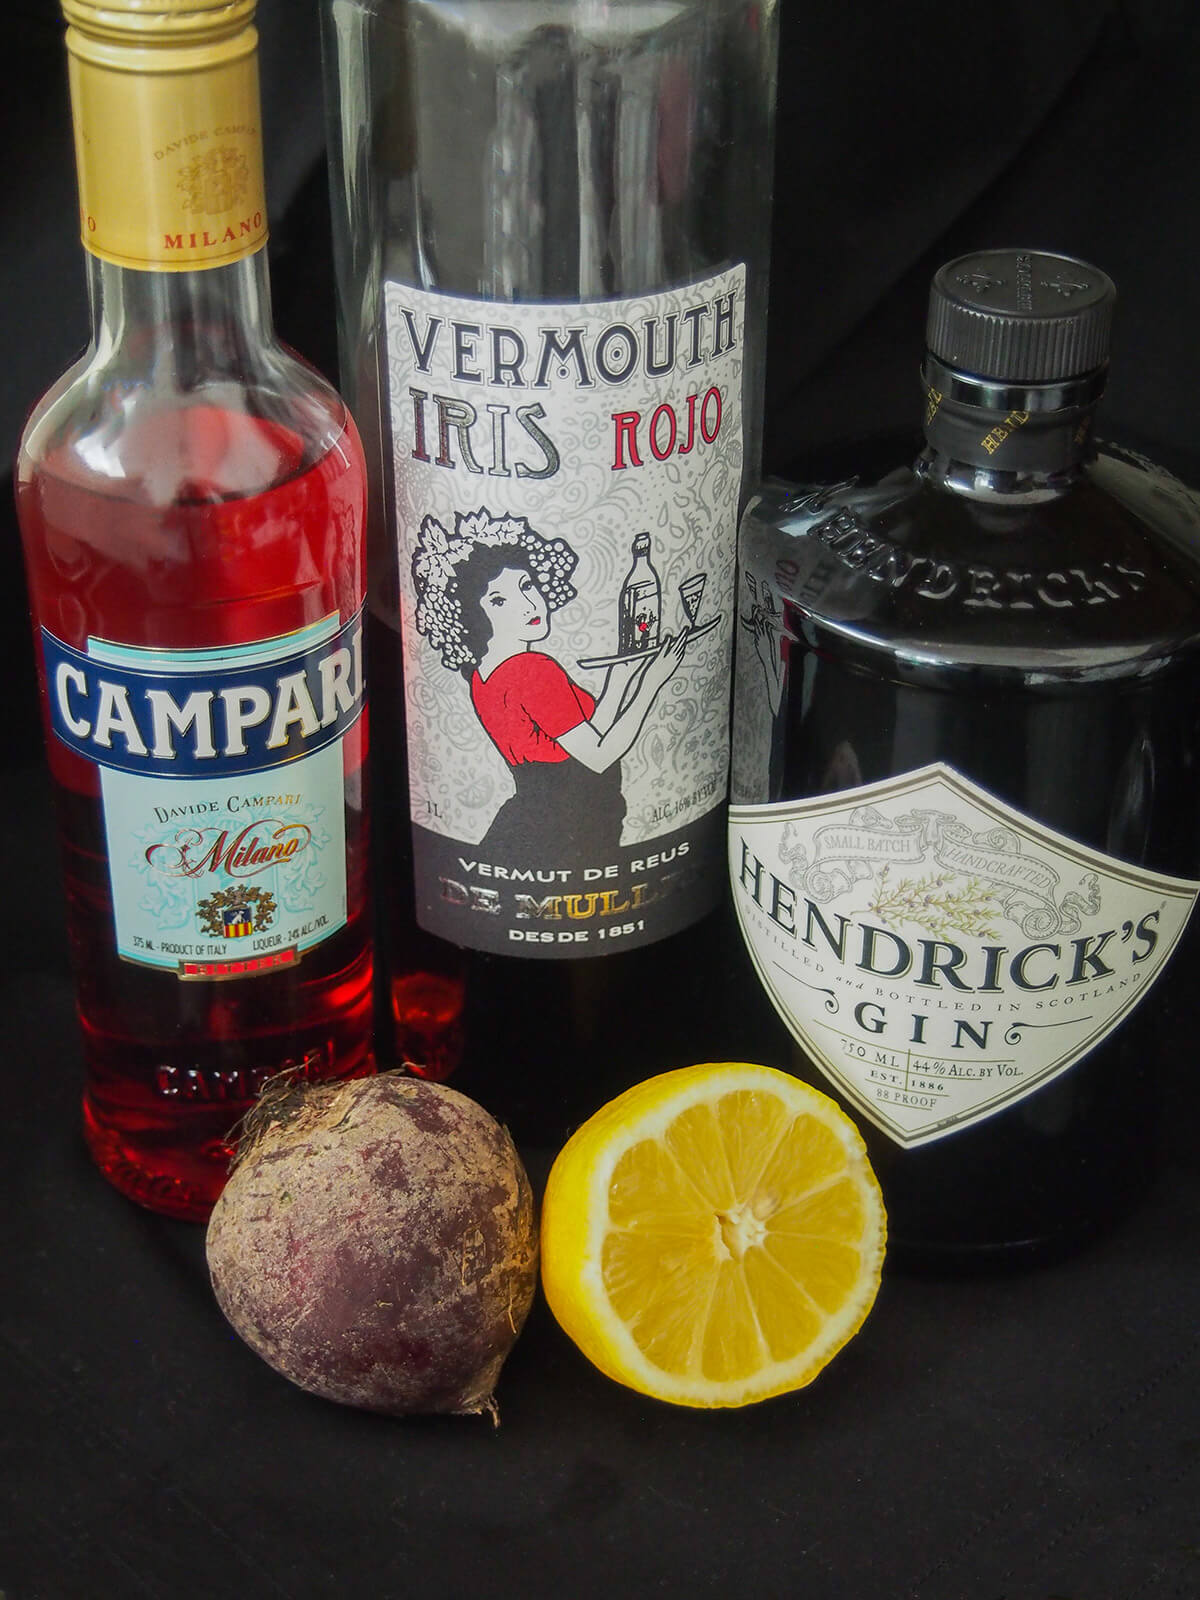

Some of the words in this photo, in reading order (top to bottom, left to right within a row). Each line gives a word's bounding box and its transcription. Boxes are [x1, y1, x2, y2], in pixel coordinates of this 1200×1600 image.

[153, 129, 208, 160] DAVIDE
[164, 211, 262, 249] MILANO
[398, 290, 737, 390] VERMOUTH
[408, 387, 560, 479] IRIS
[611, 387, 723, 471] ROJO
[56, 629, 367, 760] CAMPARI
[458, 857, 572, 883] VERMUT
[584, 864, 619, 881] DE
[631, 841, 691, 874] REUS
[825, 836, 865, 850] SMALL
[867, 838, 911, 853] BATCH
[947, 848, 1050, 889] HANDCRAFTED
[439, 876, 502, 915] DE
[508, 929, 589, 944] DESDE
[598, 920, 646, 939] 1851
[739, 838, 1160, 993] HENDRICK'S
[161, 942, 193, 955] PRODUCT
[195, 944, 205, 955] OF
[206, 944, 228, 955] ITALY
[253, 934, 282, 951] LIQUEUR
[835, 974, 864, 990] and
[875, 987, 982, 1011] BOTTLED
[997, 1002, 1021, 1012] IN
[1035, 972, 1142, 1010] SCOTLAND
[854, 1001, 994, 1050] GIN
[840, 1038, 866, 1057] 750
[874, 1052, 899, 1068] ML
[870, 1069, 903, 1085] EST.
[911, 1079, 944, 1091] 1886
[876, 1088, 890, 1099] 88
[894, 1092, 937, 1108] PROOF
